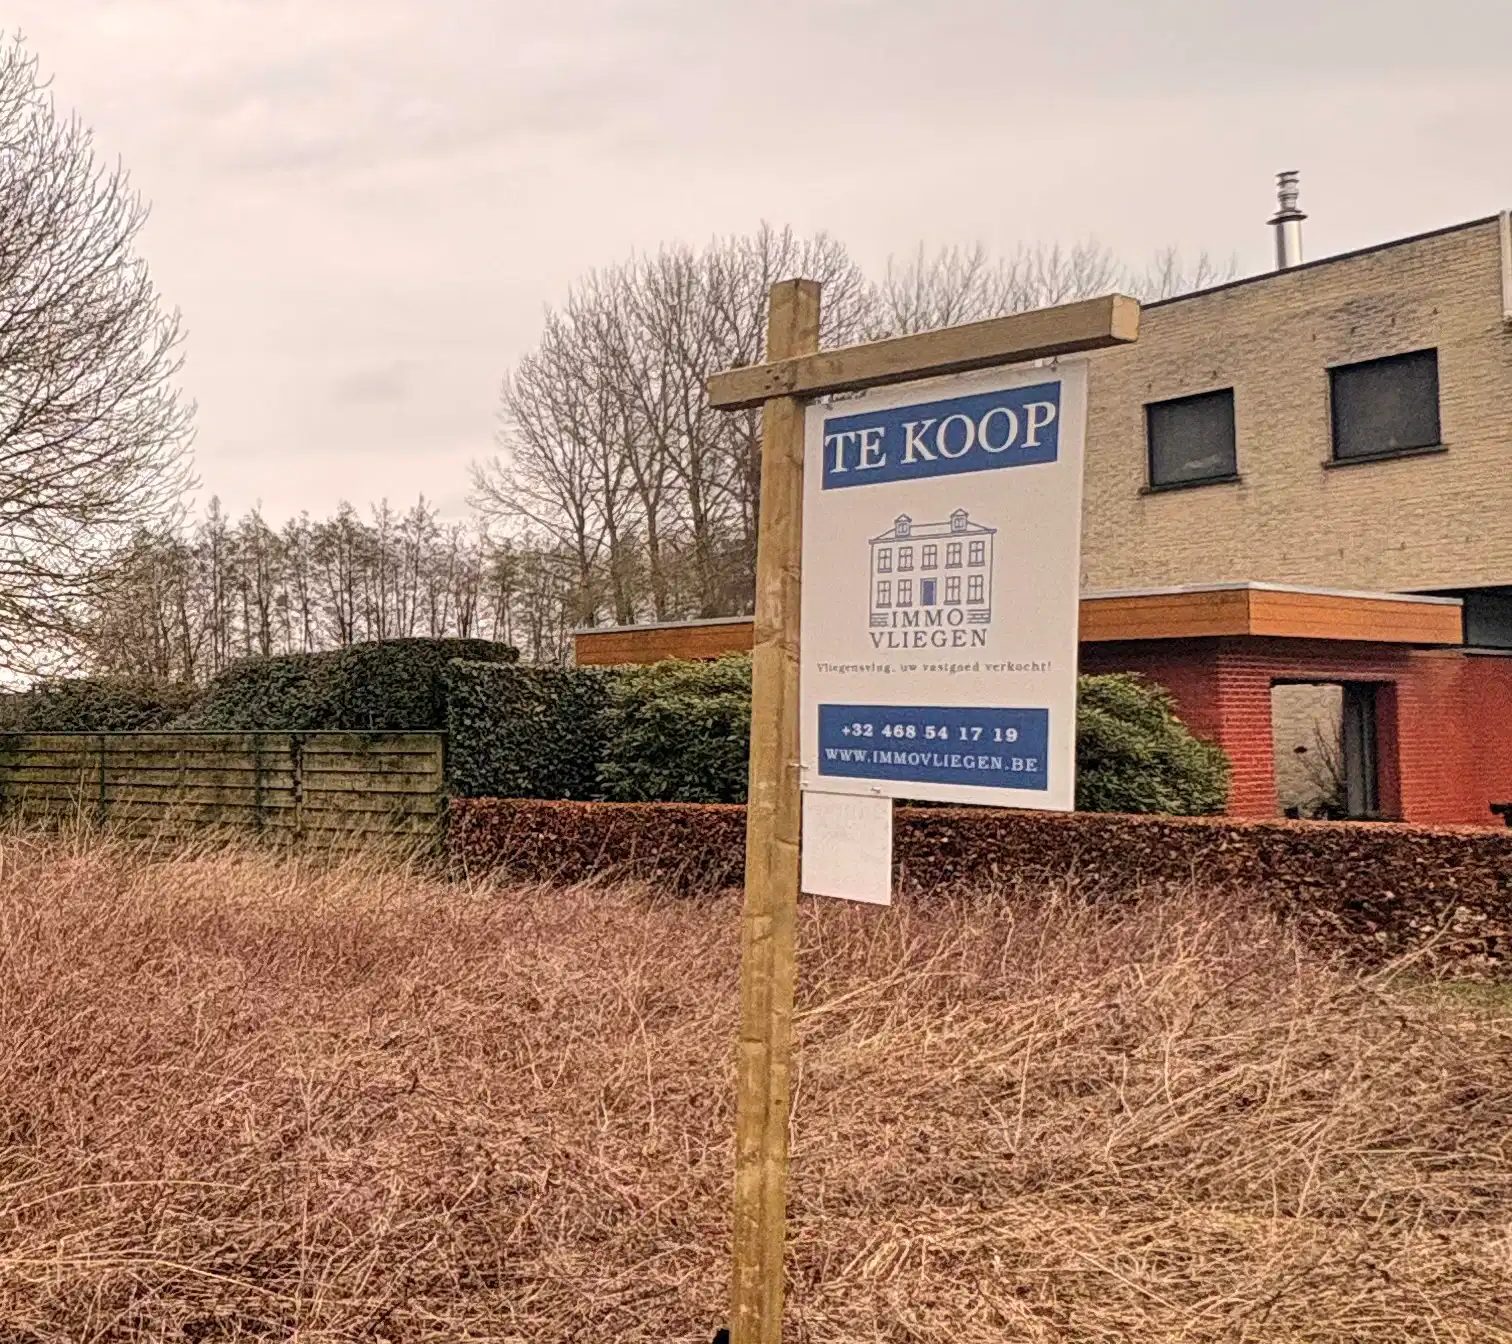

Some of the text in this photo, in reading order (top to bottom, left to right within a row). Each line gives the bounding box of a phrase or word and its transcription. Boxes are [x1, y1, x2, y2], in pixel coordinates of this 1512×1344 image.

[824, 401, 1056, 473] TE KOOP
[892, 608, 964, 628] IMMO
[869, 629, 987, 648] VLIEGEN
[842, 723, 1018, 742] +32 468 54 17 19
[825, 748, 1038, 772] WWW.IMMOVLIEGEN.BE
